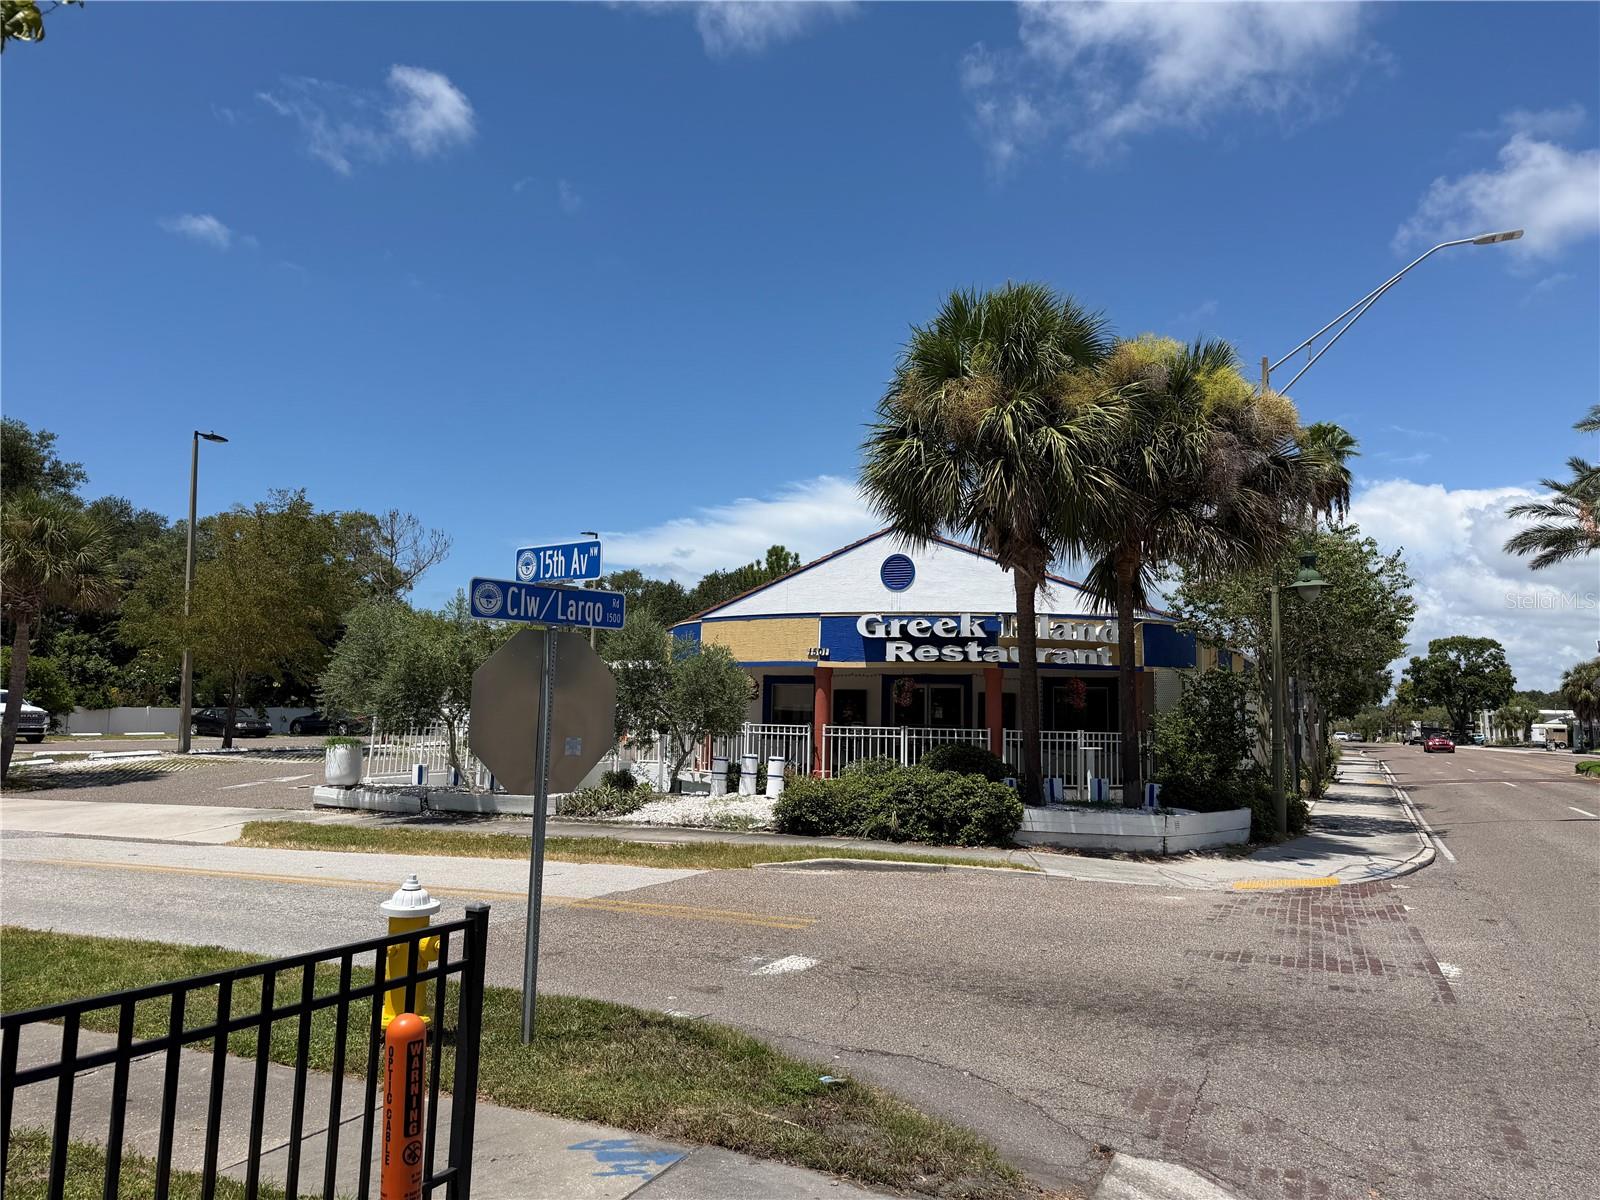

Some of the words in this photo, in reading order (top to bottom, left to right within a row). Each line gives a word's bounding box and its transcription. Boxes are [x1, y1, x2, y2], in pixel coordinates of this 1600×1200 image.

[539, 549, 566, 579] 15th
[570, 547, 588, 576] Av
[589, 546, 598, 558] NW
[507, 586, 603, 626] Clw/Largo
[606, 612, 621, 624] 1500
[612, 598, 620, 609] Rd
[856, 613, 987, 639] Greek
[998, 613, 1120, 643] Iland
[409, 1041, 422, 1135] WARNING
